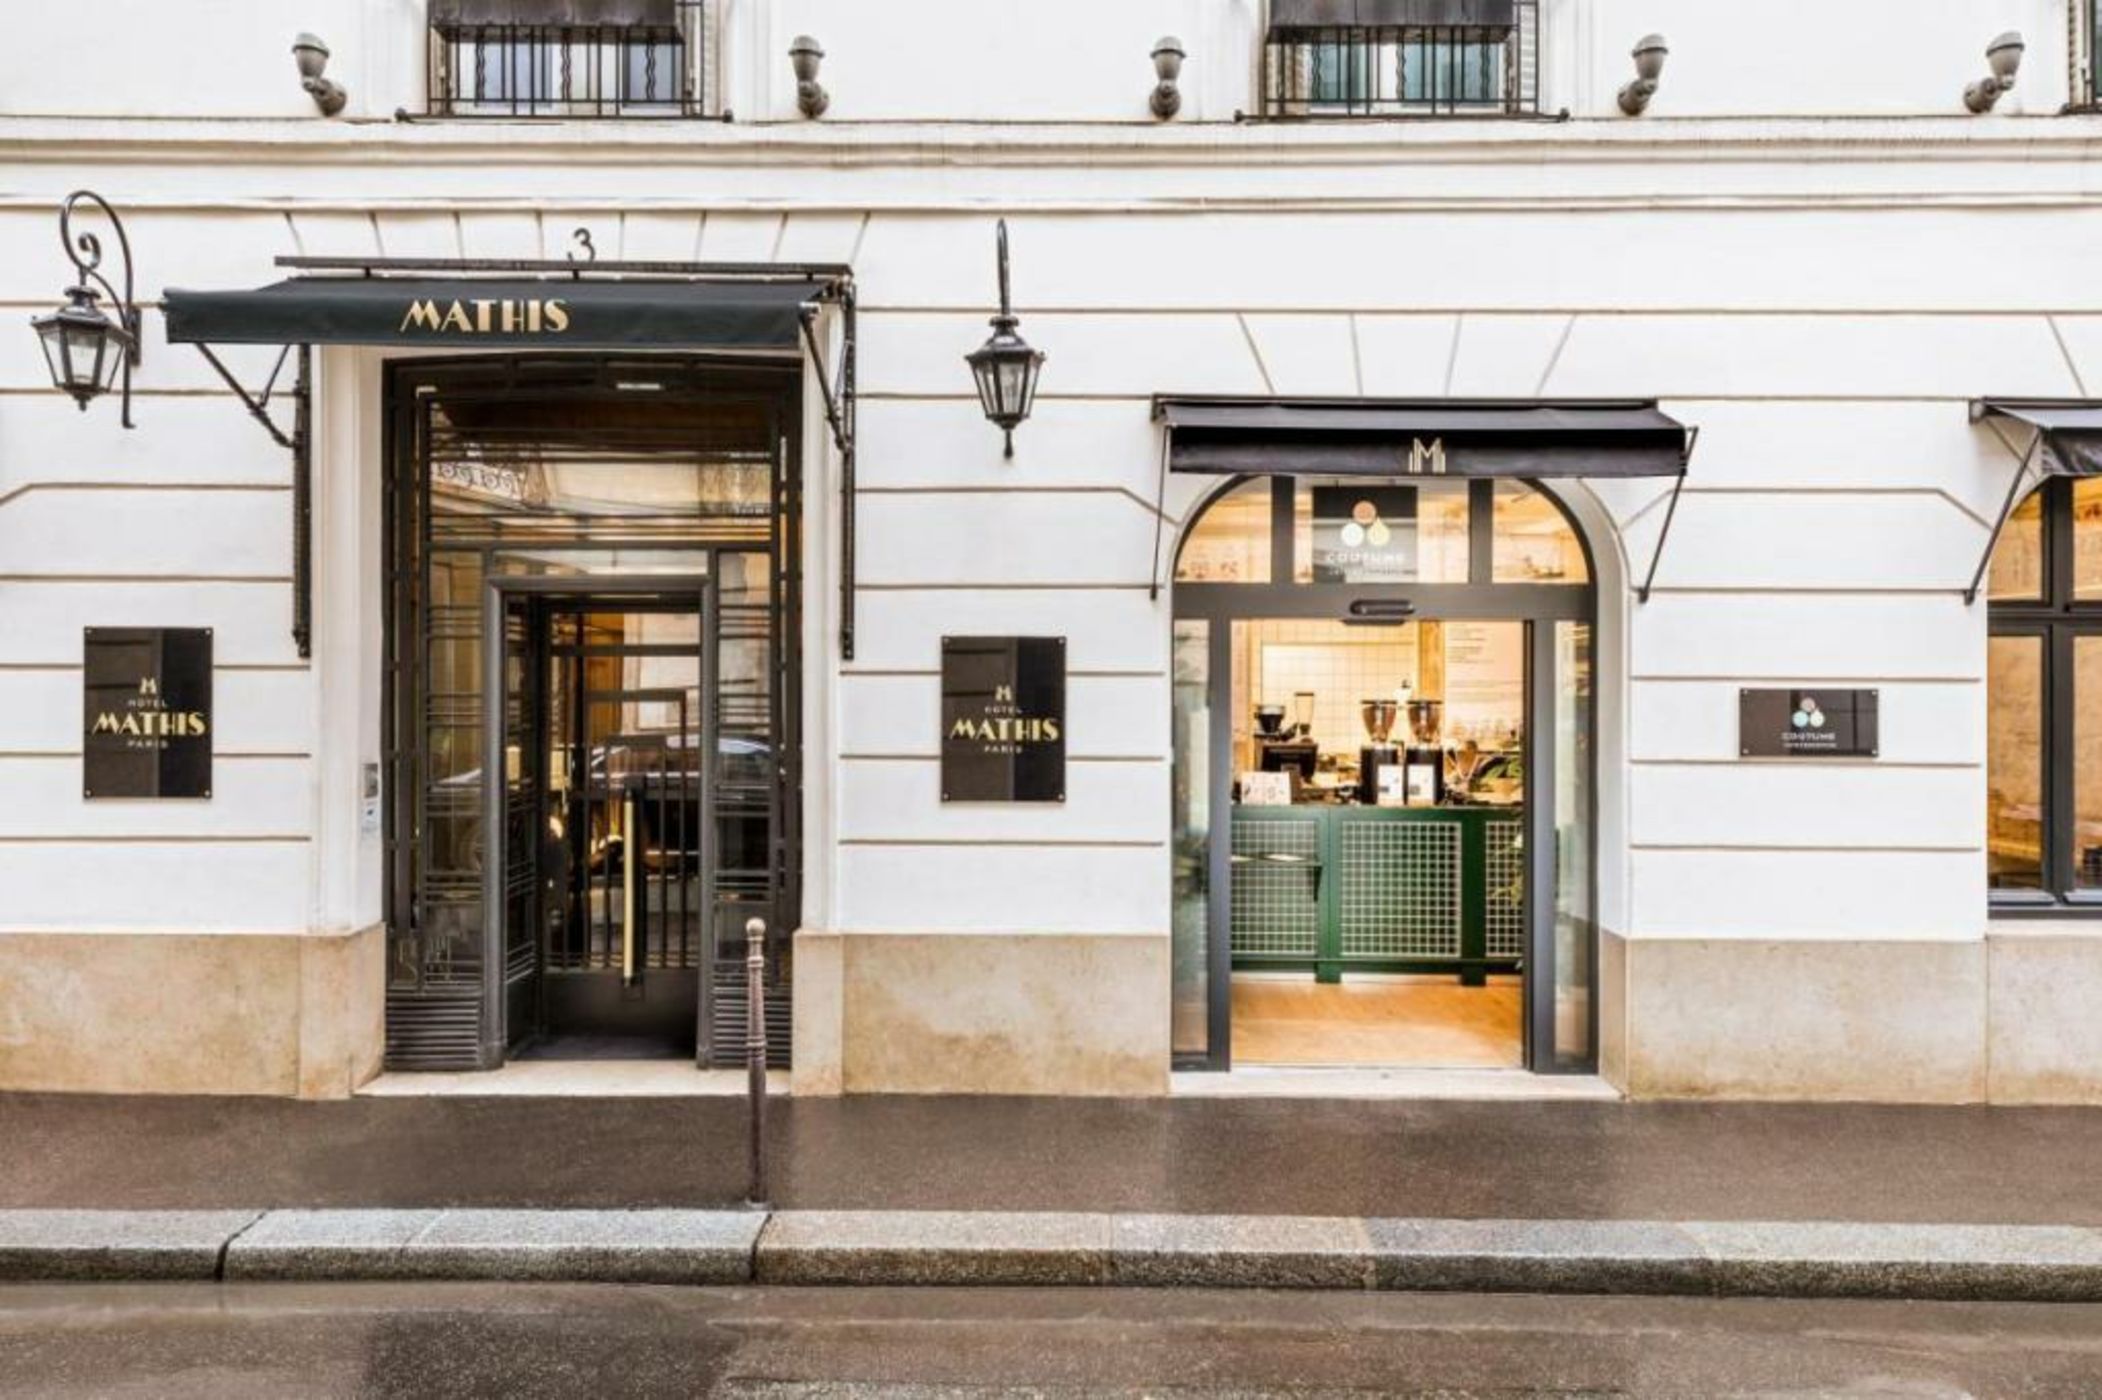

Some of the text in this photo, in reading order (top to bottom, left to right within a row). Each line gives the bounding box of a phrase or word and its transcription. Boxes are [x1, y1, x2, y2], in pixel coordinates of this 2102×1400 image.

[567, 227, 595, 263] 3
[399, 298, 570, 333] MATHIS
[1408, 437, 1446, 474] M
[92, 711, 207, 736] MATHIS
[949, 718, 1060, 742] MATHIS
[127, 740, 169, 749] PARIS
[984, 745, 1023, 754] PARIS
